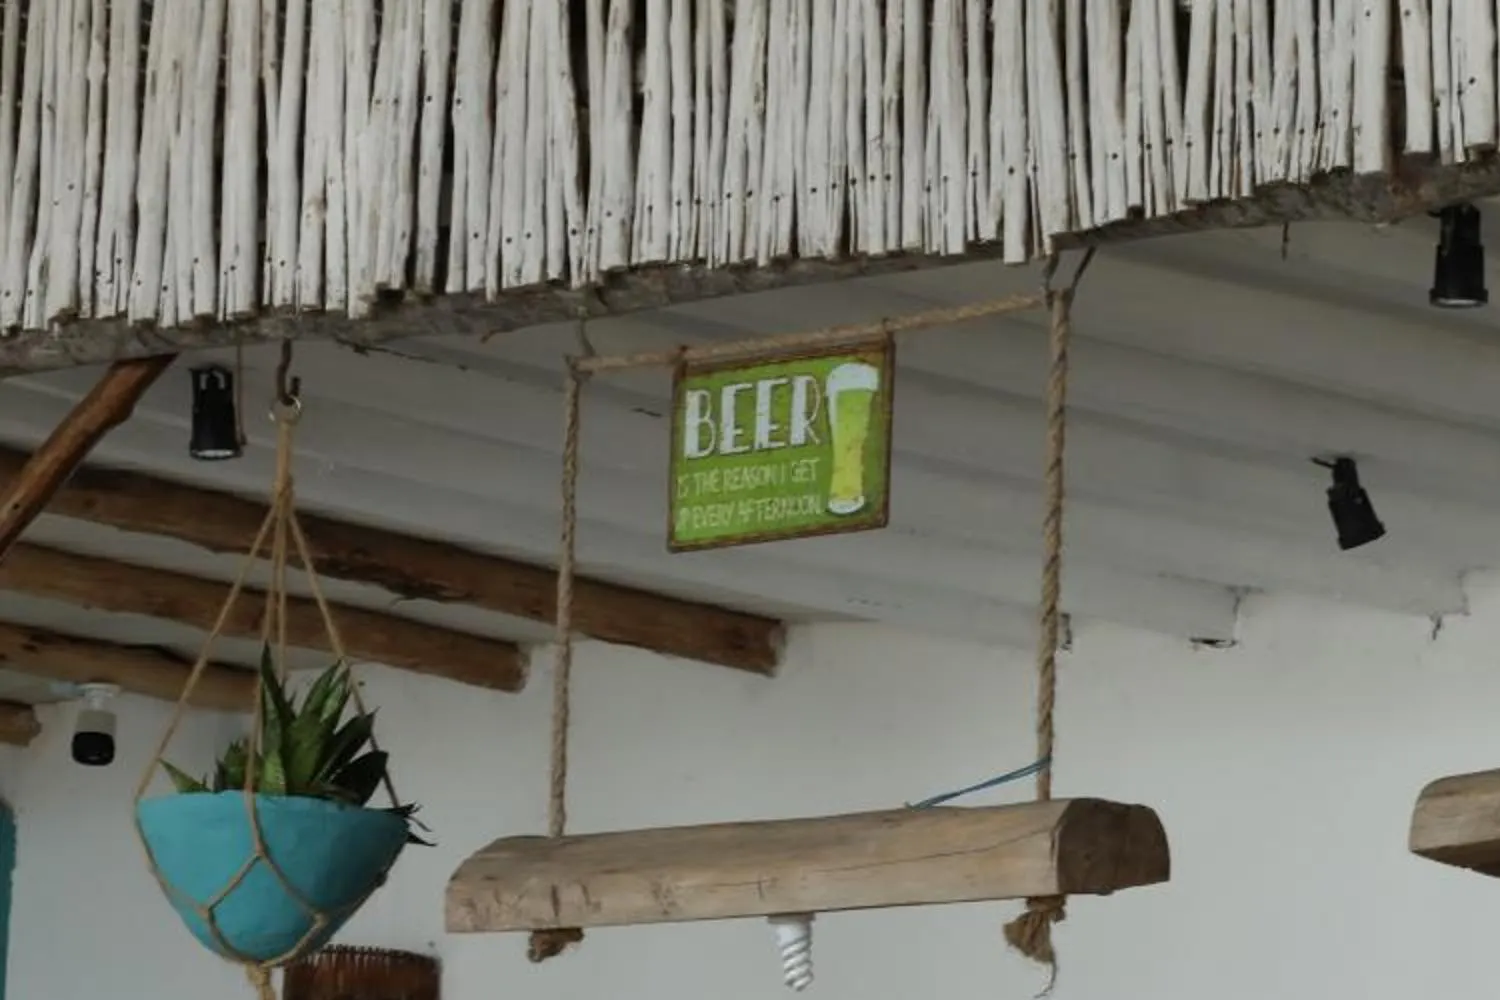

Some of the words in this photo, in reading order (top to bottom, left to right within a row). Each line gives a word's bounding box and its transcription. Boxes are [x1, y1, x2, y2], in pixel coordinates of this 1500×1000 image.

[684, 375, 821, 459] BEER
[695, 467, 721, 496] THE
[723, 463, 776, 494] REASON
[792, 457, 820, 483] GET
[692, 501, 735, 529] EVERY
